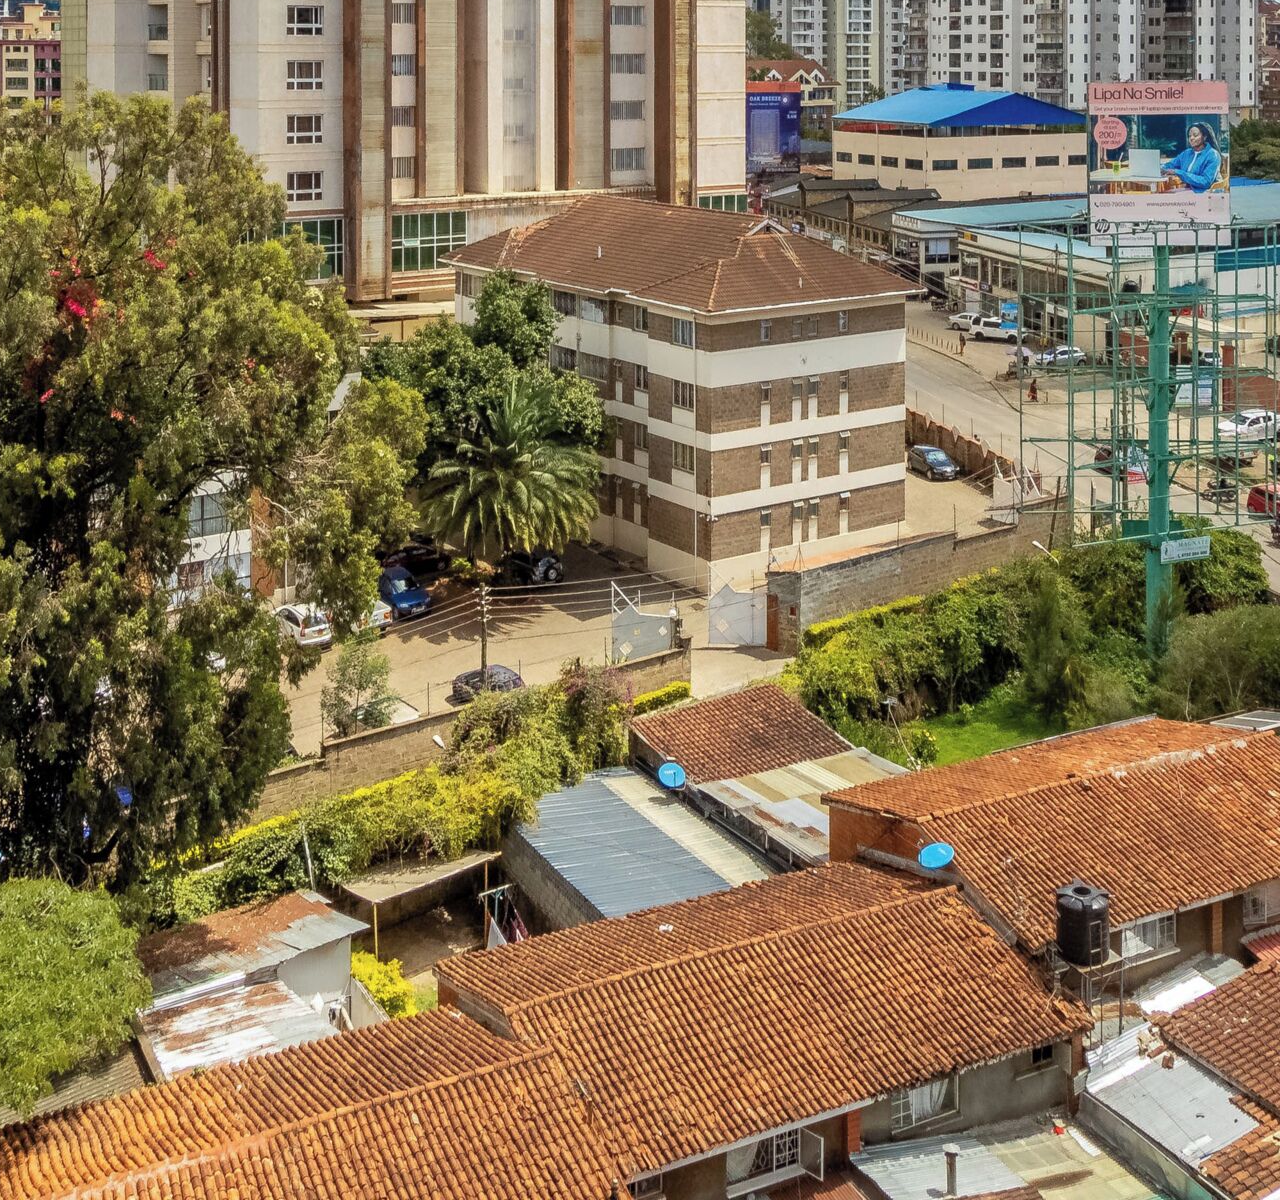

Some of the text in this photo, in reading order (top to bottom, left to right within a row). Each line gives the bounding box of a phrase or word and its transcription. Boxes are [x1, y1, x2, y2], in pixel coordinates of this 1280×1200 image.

[1094, 86, 1184, 102] Lipa Na Smile!
